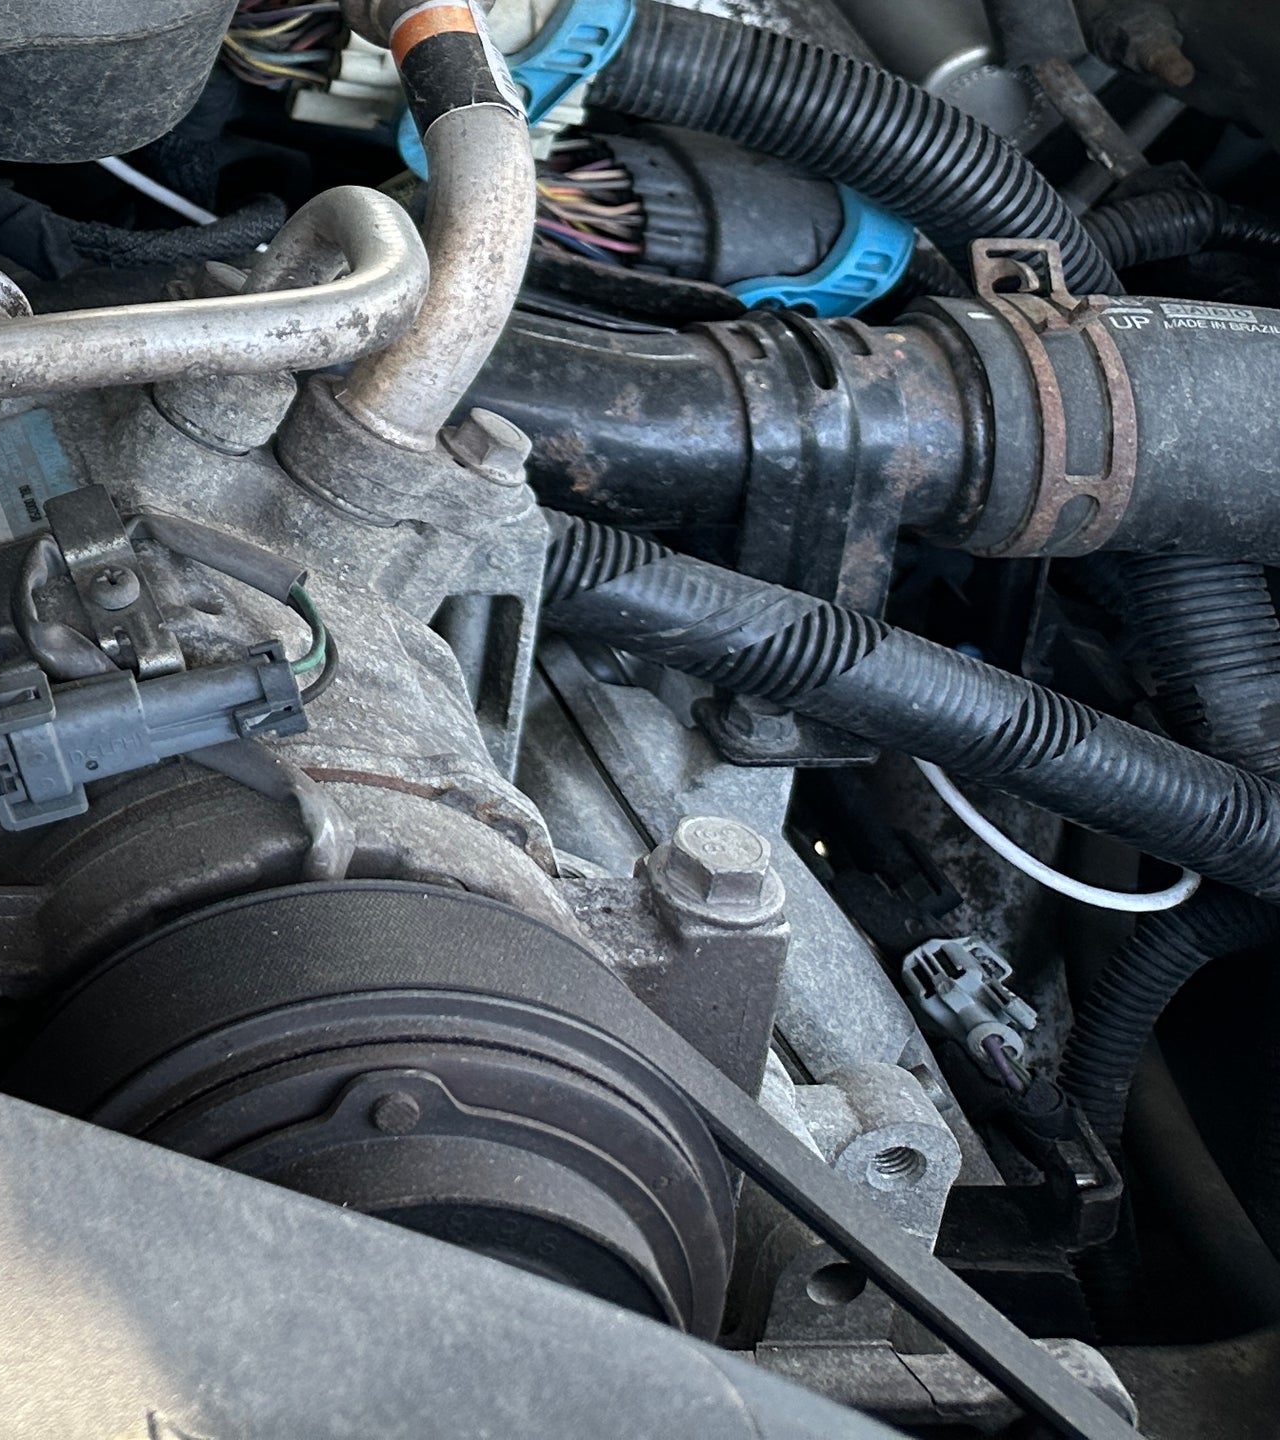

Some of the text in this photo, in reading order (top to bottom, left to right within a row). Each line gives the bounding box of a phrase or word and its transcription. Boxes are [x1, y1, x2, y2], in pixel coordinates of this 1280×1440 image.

[1108, 315, 1151, 330] UP
[1164, 318, 1208, 330] MADE
[1211, 322, 1227, 331] IN
